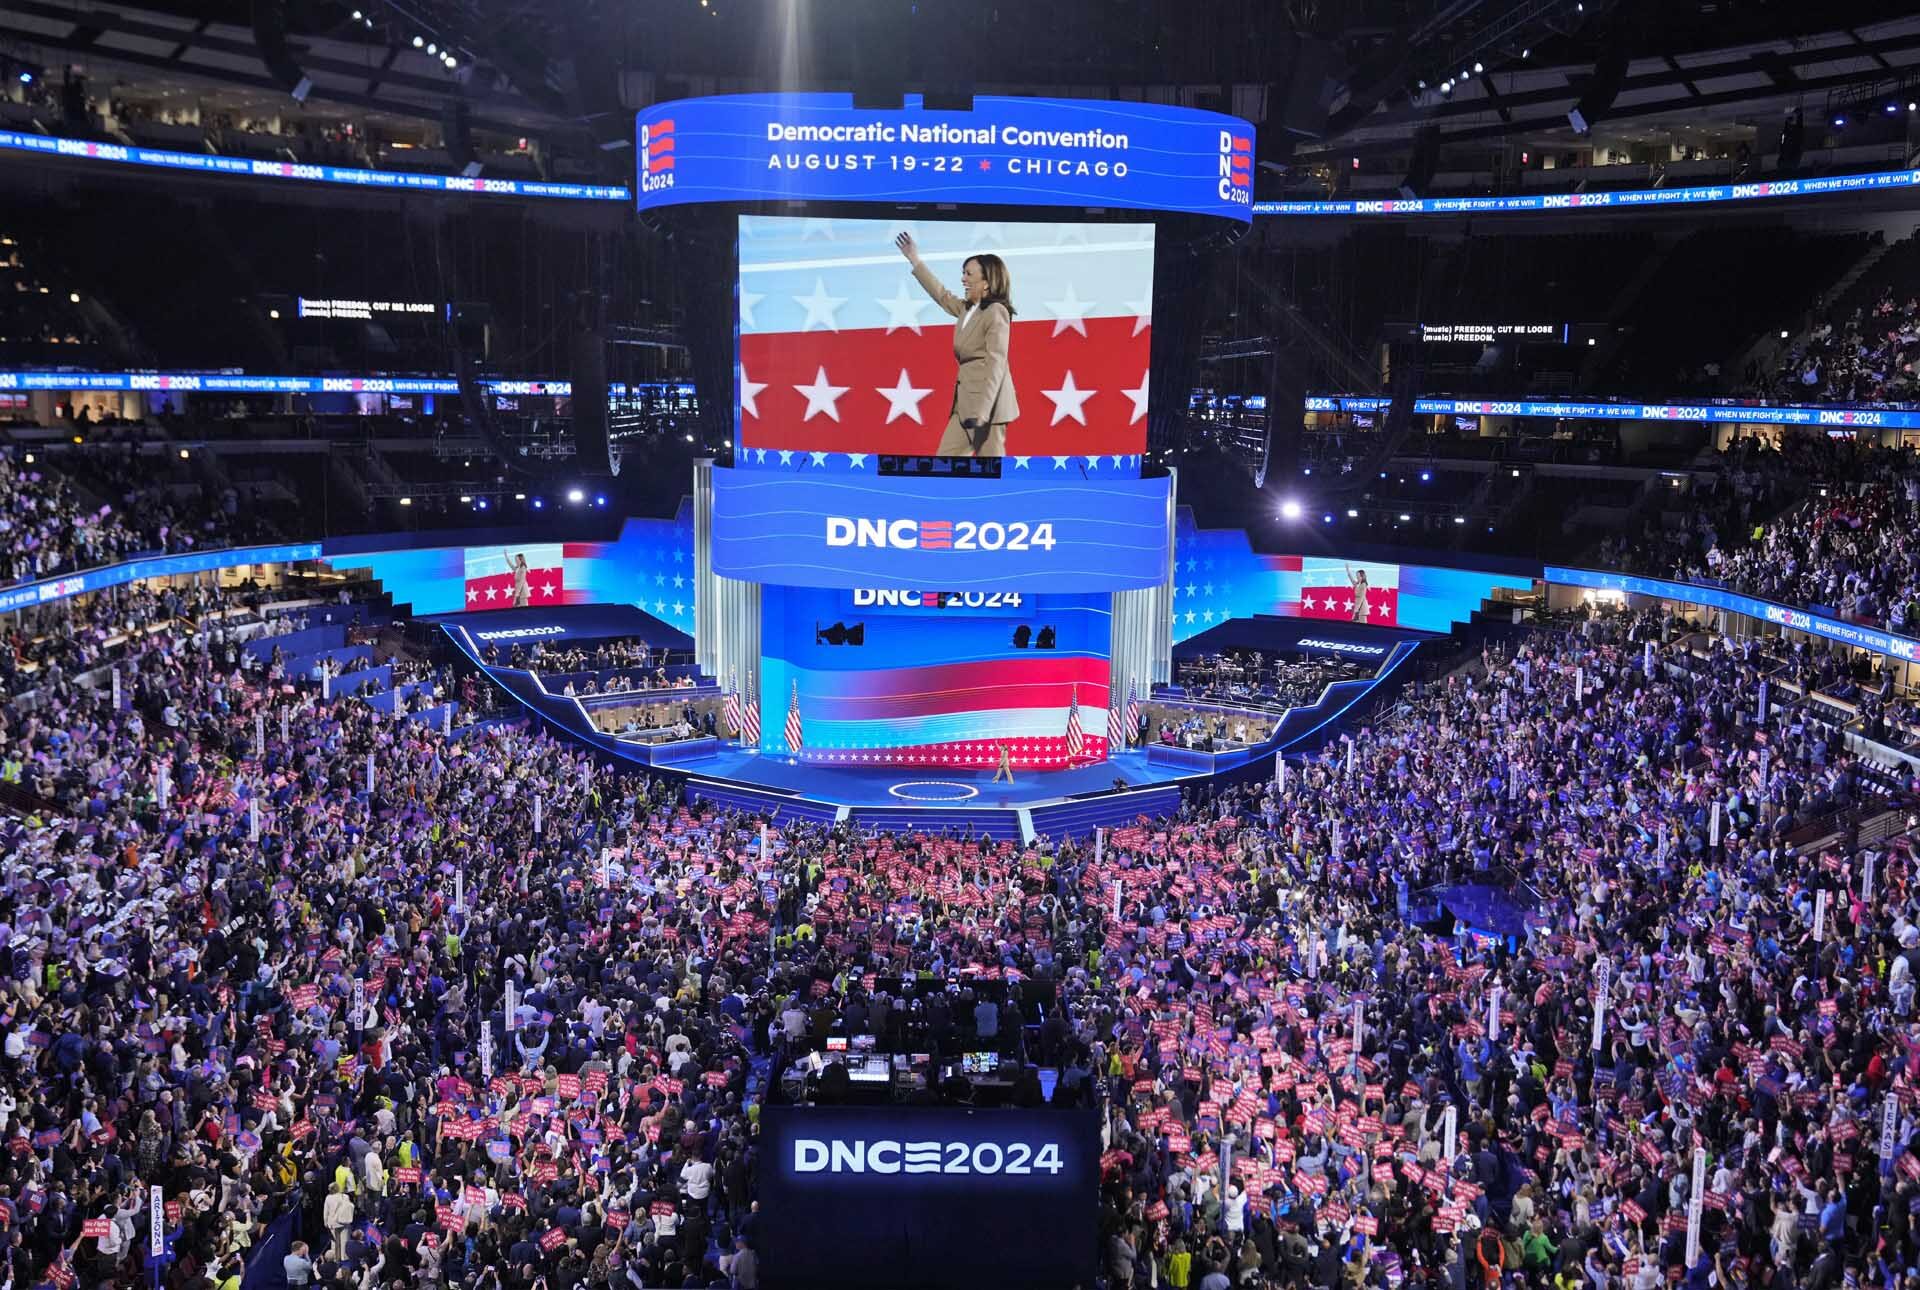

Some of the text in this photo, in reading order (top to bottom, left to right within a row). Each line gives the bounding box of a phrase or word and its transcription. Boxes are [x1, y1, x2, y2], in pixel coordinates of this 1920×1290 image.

[768, 122, 1129, 150] Democratic National Convention
[768, 154, 1128, 177] AUGUST 19-22 CHICAGO
[649, 173, 674, 189] 2024
[1843, 178, 1866, 186] FIGHT
[1878, 176, 1890, 184] WE
[1892, 175, 1909, 183] WIN
[1231, 188, 1249, 205] 2024
[373, 302, 390, 310] CUT
[1453, 334, 1496, 342] FREEDOM,
[1454, 326, 1496, 334] FREEDOM,
[1491, 402, 1521, 414] 2024
[1678, 407, 1707, 419] 2024
[1853, 413, 1881, 425] 2024
[954, 521, 1056, 551] 2024
[1791, 611, 1811, 629] 2024
[1883, 1102, 1895, 1150] TEXAS
[944, 1141, 1063, 1174] 2024
[153, 1195, 161, 1246] ARIZONA
